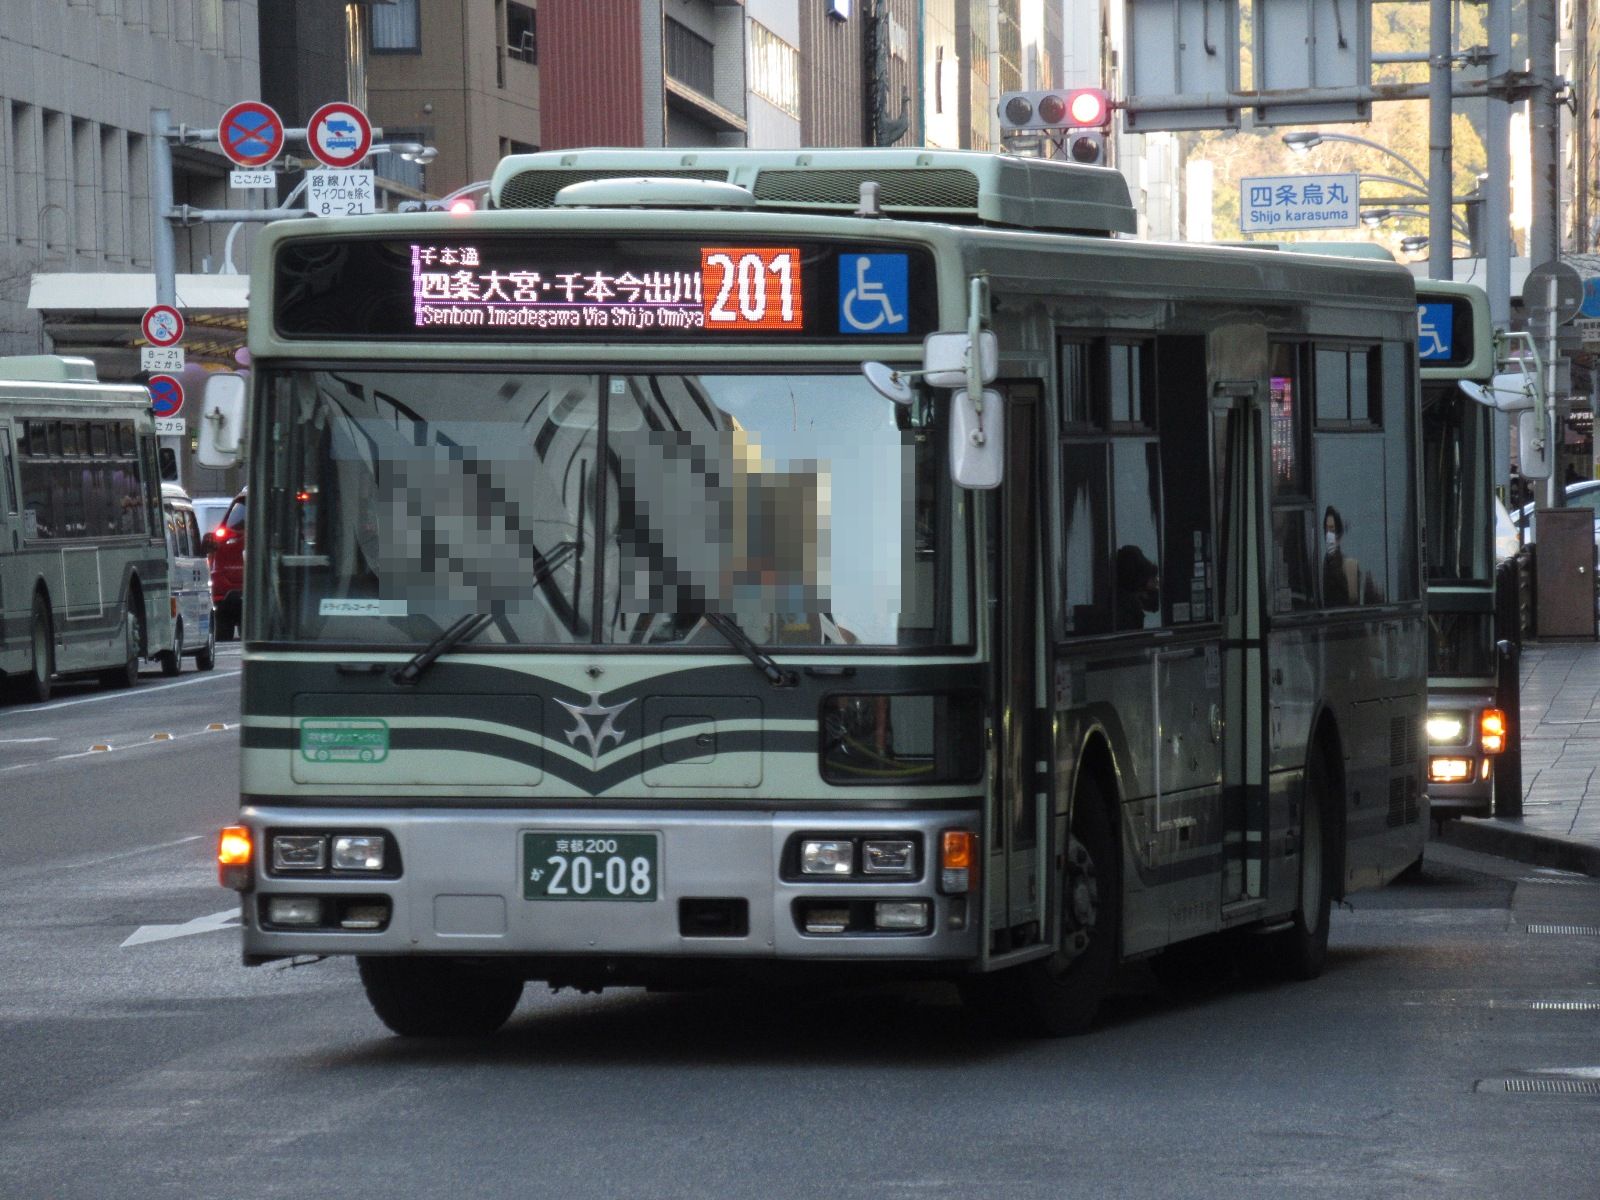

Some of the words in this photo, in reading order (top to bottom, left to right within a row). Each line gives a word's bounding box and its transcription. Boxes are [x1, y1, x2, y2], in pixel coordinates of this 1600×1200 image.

[233, 175, 272, 184] ここから
[312, 175, 370, 187] 路線バス
[312, 188, 371, 200] マイクロを除く
[1250, 182, 1349, 208] 四条烏丸
[1250, 210, 1281, 224] Shijo
[1285, 209, 1349, 221] karasuma
[420, 246, 480, 266] 千本通
[706, 253, 794, 322] 201
[422, 305, 484, 325] Senbon
[487, 305, 580, 327] Imadegawa
[582, 306, 608, 326] Via
[610, 306, 655, 328] Shijo
[656, 307, 704, 328] Omiya
[143, 361, 182, 369] ここから
[530, 868, 545, 882] か
[546, 855, 651, 896] 20-08
